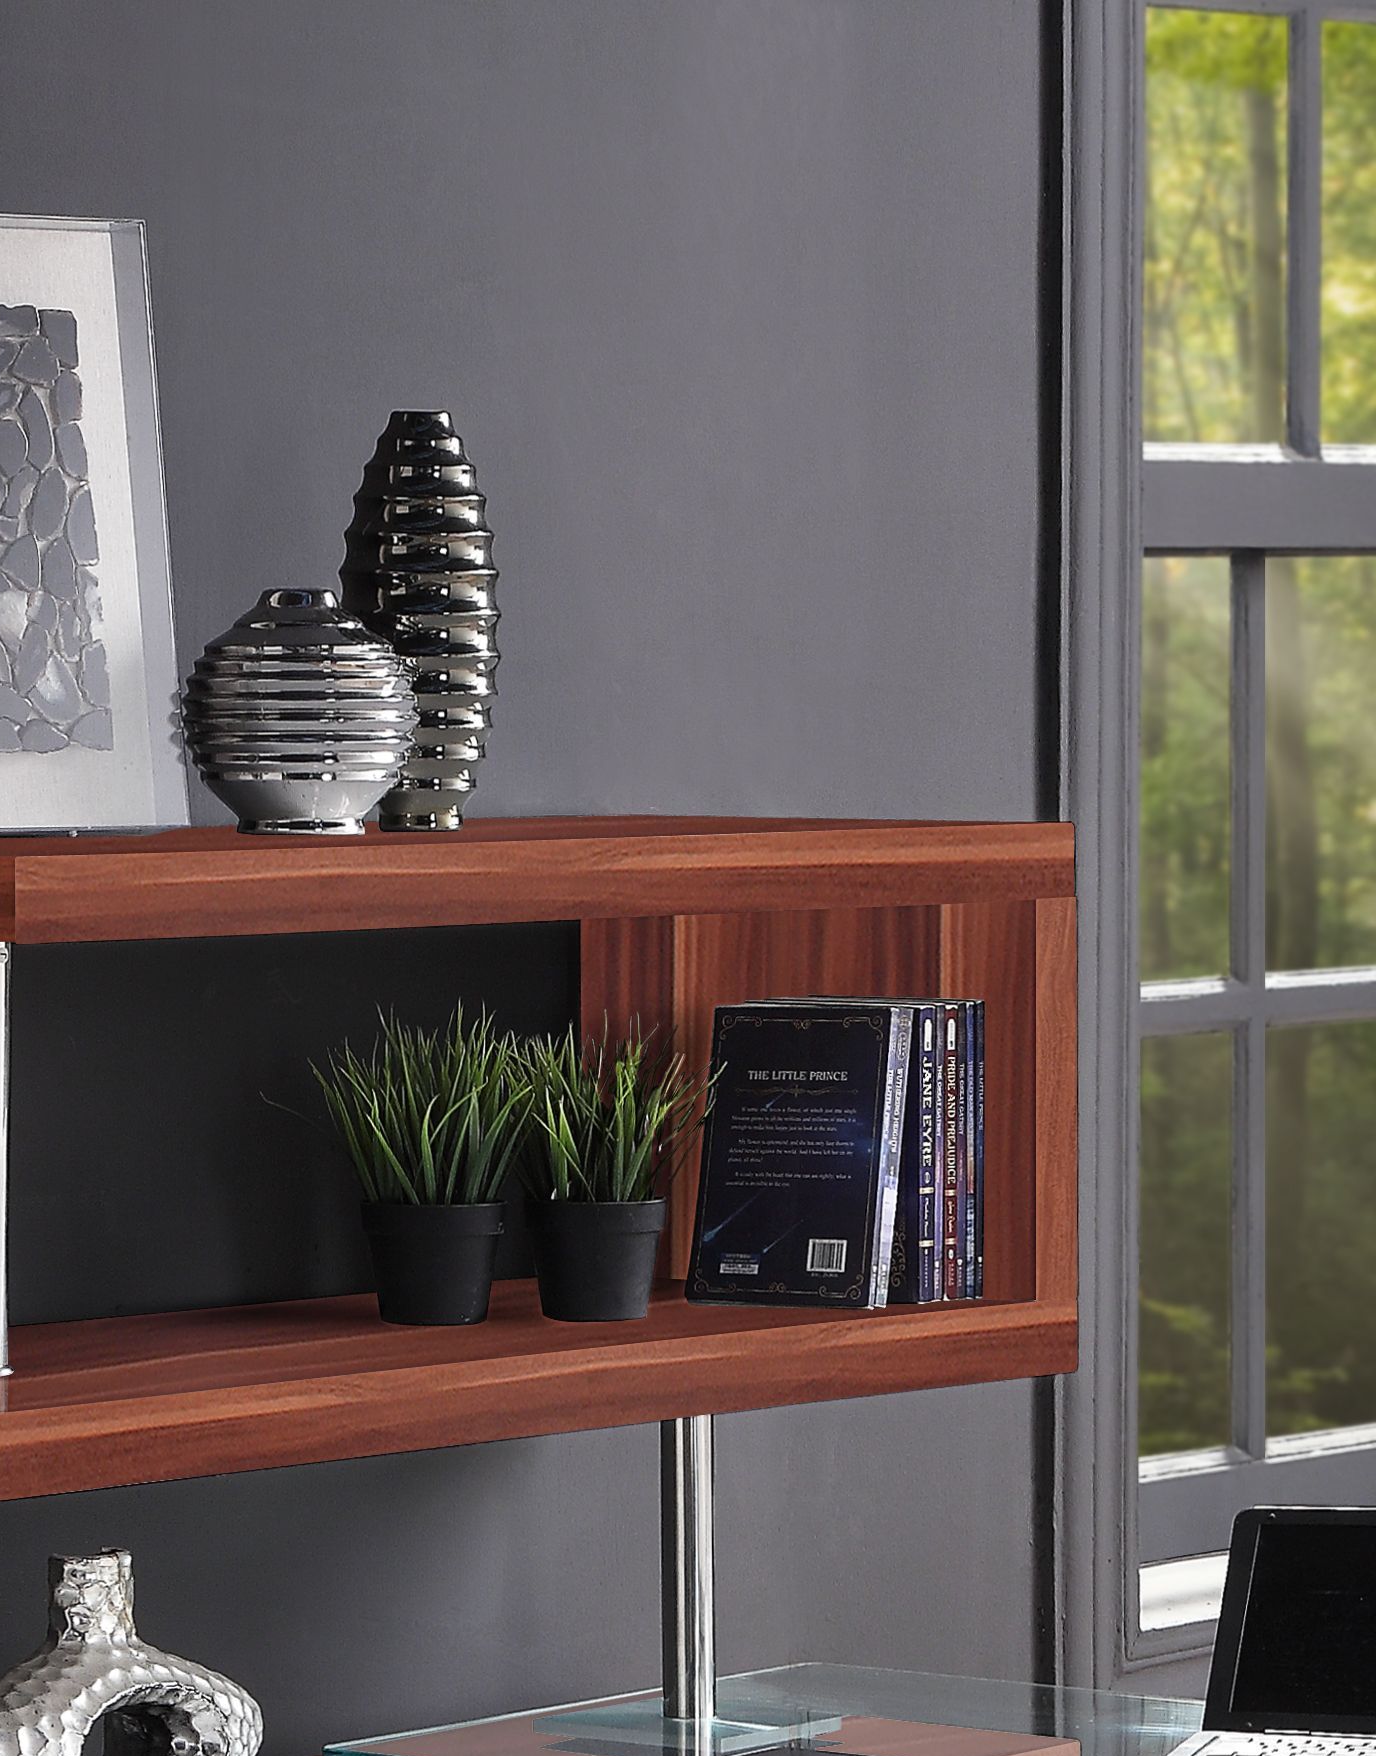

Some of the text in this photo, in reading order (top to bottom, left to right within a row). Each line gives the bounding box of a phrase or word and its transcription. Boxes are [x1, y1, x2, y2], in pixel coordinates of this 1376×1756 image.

[748, 1070, 848, 1081] THE LITTLE PRINCE
[922, 1056, 933, 1168] JANE EYRE
[946, 1056, 956, 1185] PRIDE AND PREJUDICE
